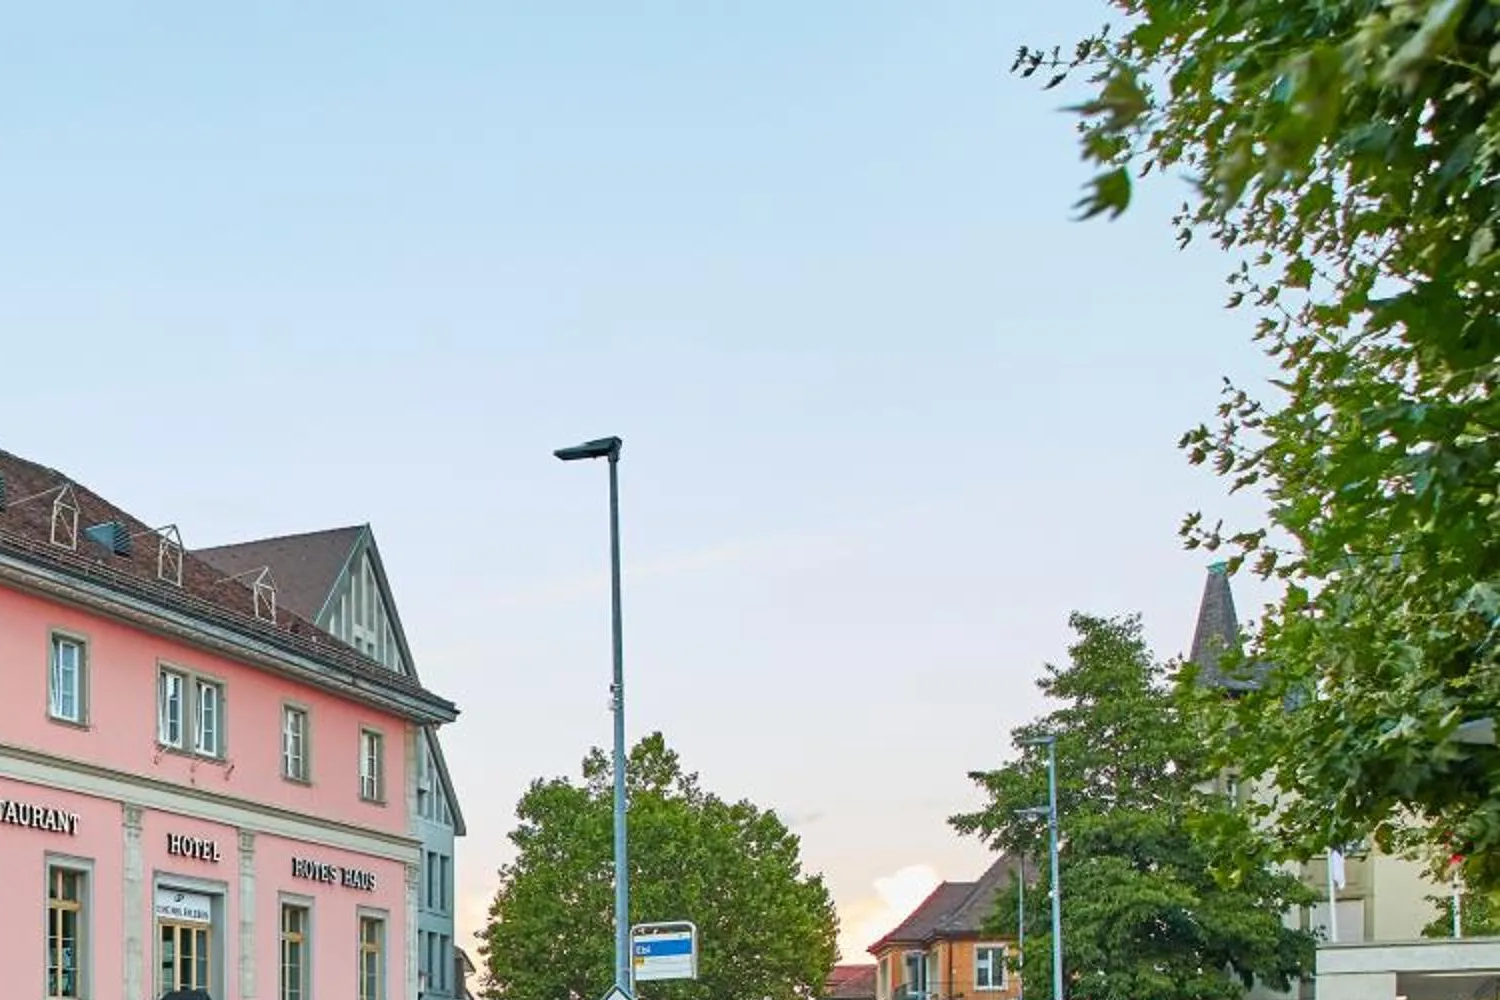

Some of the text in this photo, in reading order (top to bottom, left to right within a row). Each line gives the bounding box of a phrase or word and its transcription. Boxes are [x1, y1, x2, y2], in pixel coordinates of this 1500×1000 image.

[167, 833, 221, 862] HOTEL
[292, 857, 377, 892] ROTES HAUS
